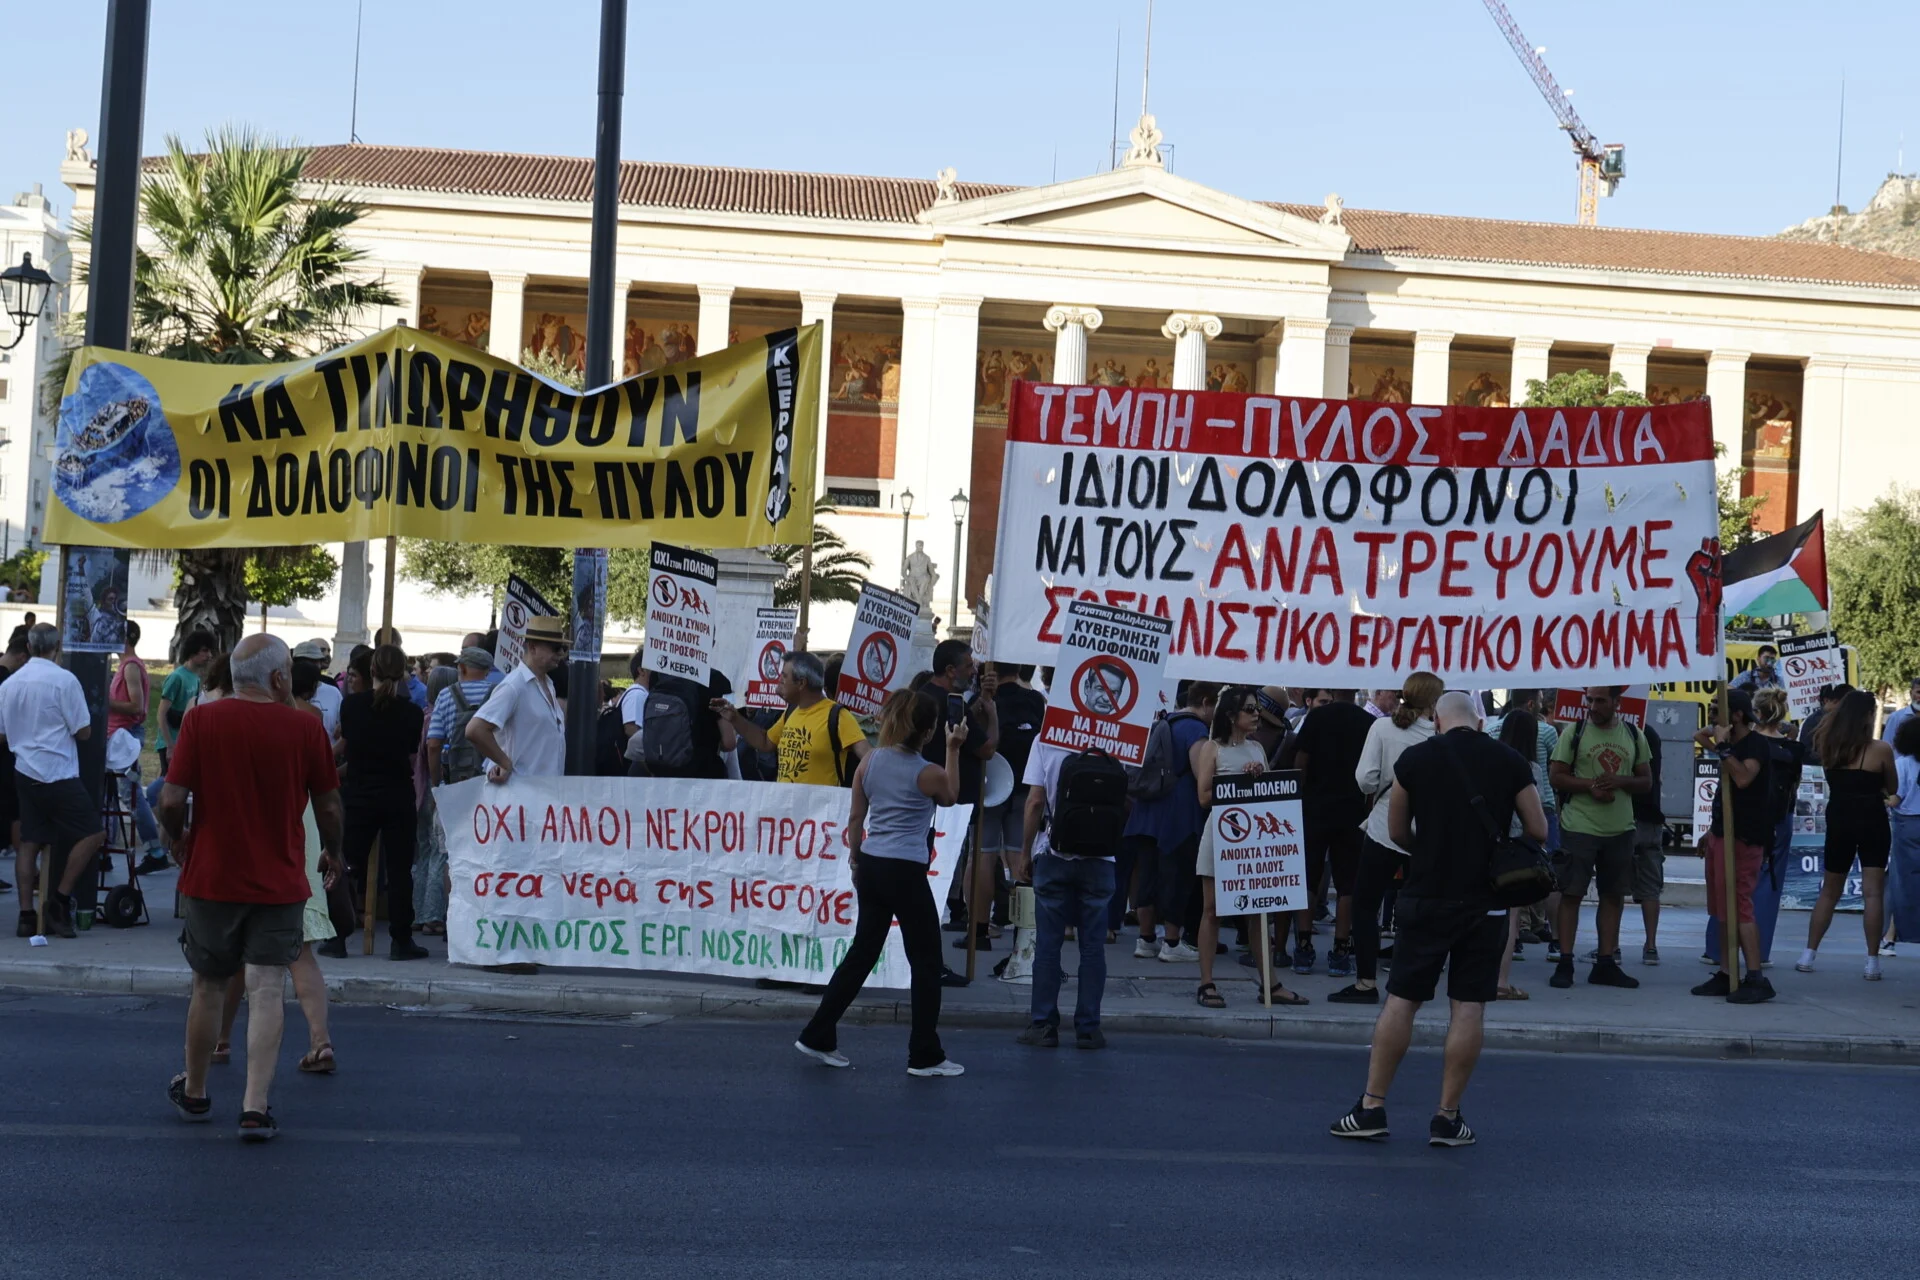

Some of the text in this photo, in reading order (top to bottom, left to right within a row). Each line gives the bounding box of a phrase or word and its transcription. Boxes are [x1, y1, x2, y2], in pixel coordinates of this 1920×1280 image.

[218, 374, 306, 443] ΝΑ
[772, 345, 792, 476] ΚΕΕΡΦΑ
[1034, 386, 1194, 449] ΤΕΜΠΗ
[1242, 398, 1442, 464] ΠΥΛΟΣ
[1498, 410, 1665, 466] ΔΑΔΙΑ
[188, 458, 230, 519] ΟΙ
[495, 453, 583, 518] ΤΗΣ
[594, 451, 754, 519] ΠΥΛΟΥ
[1059, 452, 1578, 526] ΙΔΙΟΙ ΔΟΛΟΦΟΝΟΙ
[1035, 515, 1085, 576] ΝΑ
[1095, 516, 1198, 580] ΤΟΥΣ
[654, 550, 670, 567] ΟΧΙ
[683, 557, 715, 579] ΠΟΛΕΜΟ
[510, 580, 524, 597] ΟΧΙ
[651, 609, 711, 636] ΑΝΟΙΧΤΑ ΣΥΝΟΡΑ
[759, 620, 793, 631] ΚΥΒΕΡΝΗΣΗ
[858, 611, 912, 641] ΔΟΛΟΦΟΝΩΝ
[864, 598, 913, 628] ΚΥΒΕΡΝΗΣΗ
[1074, 604, 1168, 632] εργατικη αλληλεγγυη
[662, 626, 700, 646] ΓΙΑ ΟΛΟΥΣ
[1037, 587, 1340, 666] ΣΛΙΣΤΙΚΟ
[1348, 614, 1521, 672] ΕΡΓΑΤΙΚΟ
[1532, 607, 1689, 672] ΚΟΜΜΑ
[1074, 619, 1160, 650] ΚΥΒΕΡΝΗΣΗ
[650, 637, 708, 664] ΤΟΥΣ ΠΡΟΣΦΥΓΕΣ
[1067, 633, 1160, 664] ΔΟΛΟΦΟΝΩΝ
[1781, 643, 1795, 653] ΟΧΙ
[670, 660, 700, 678] ΚΕΕΡΦΑ
[1789, 677, 1816, 688] ΑΝΟΙΧΤΑ
[855, 681, 884, 703] ΝΑ ΤΗΝ
[1072, 714, 1120, 739] ΝΑ ΤΗΝ
[779, 748, 811, 760] LESTINE
[787, 740, 802, 749] SEA
[1045, 726, 1140, 760] ΑΝΑΤΡΕΨΟΥΜΕ
[1698, 764, 1713, 775] ΟΧΙ
[1216, 780, 1297, 800] ΟΧΙ ΣΤΟΝ ΠΟΛΕΜΟ
[473, 804, 526, 844] ΟΧΙ
[541, 804, 631, 850] ΑΛΛΟΙ
[646, 807, 745, 854] ΝΕΚΡΟΙ
[1220, 843, 1299, 861] ΑΝΟΙΧΤΑ ΣΥΝΟΡΑ
[1801, 855, 1819, 873] ΟΙ
[1237, 860, 1284, 875] ΓΙΑ ΟΛΟΥΣ
[474, 872, 544, 898] στα
[655, 879, 714, 909] της
[1222, 874, 1300, 892] ΤΟΥΣ ΠΡΟΣΦΥΓΕΣ
[1252, 895, 1289, 909] ΚΕΕΡΦΑ
[475, 918, 630, 956] ΣΥΛΛΟΓΟΣ
